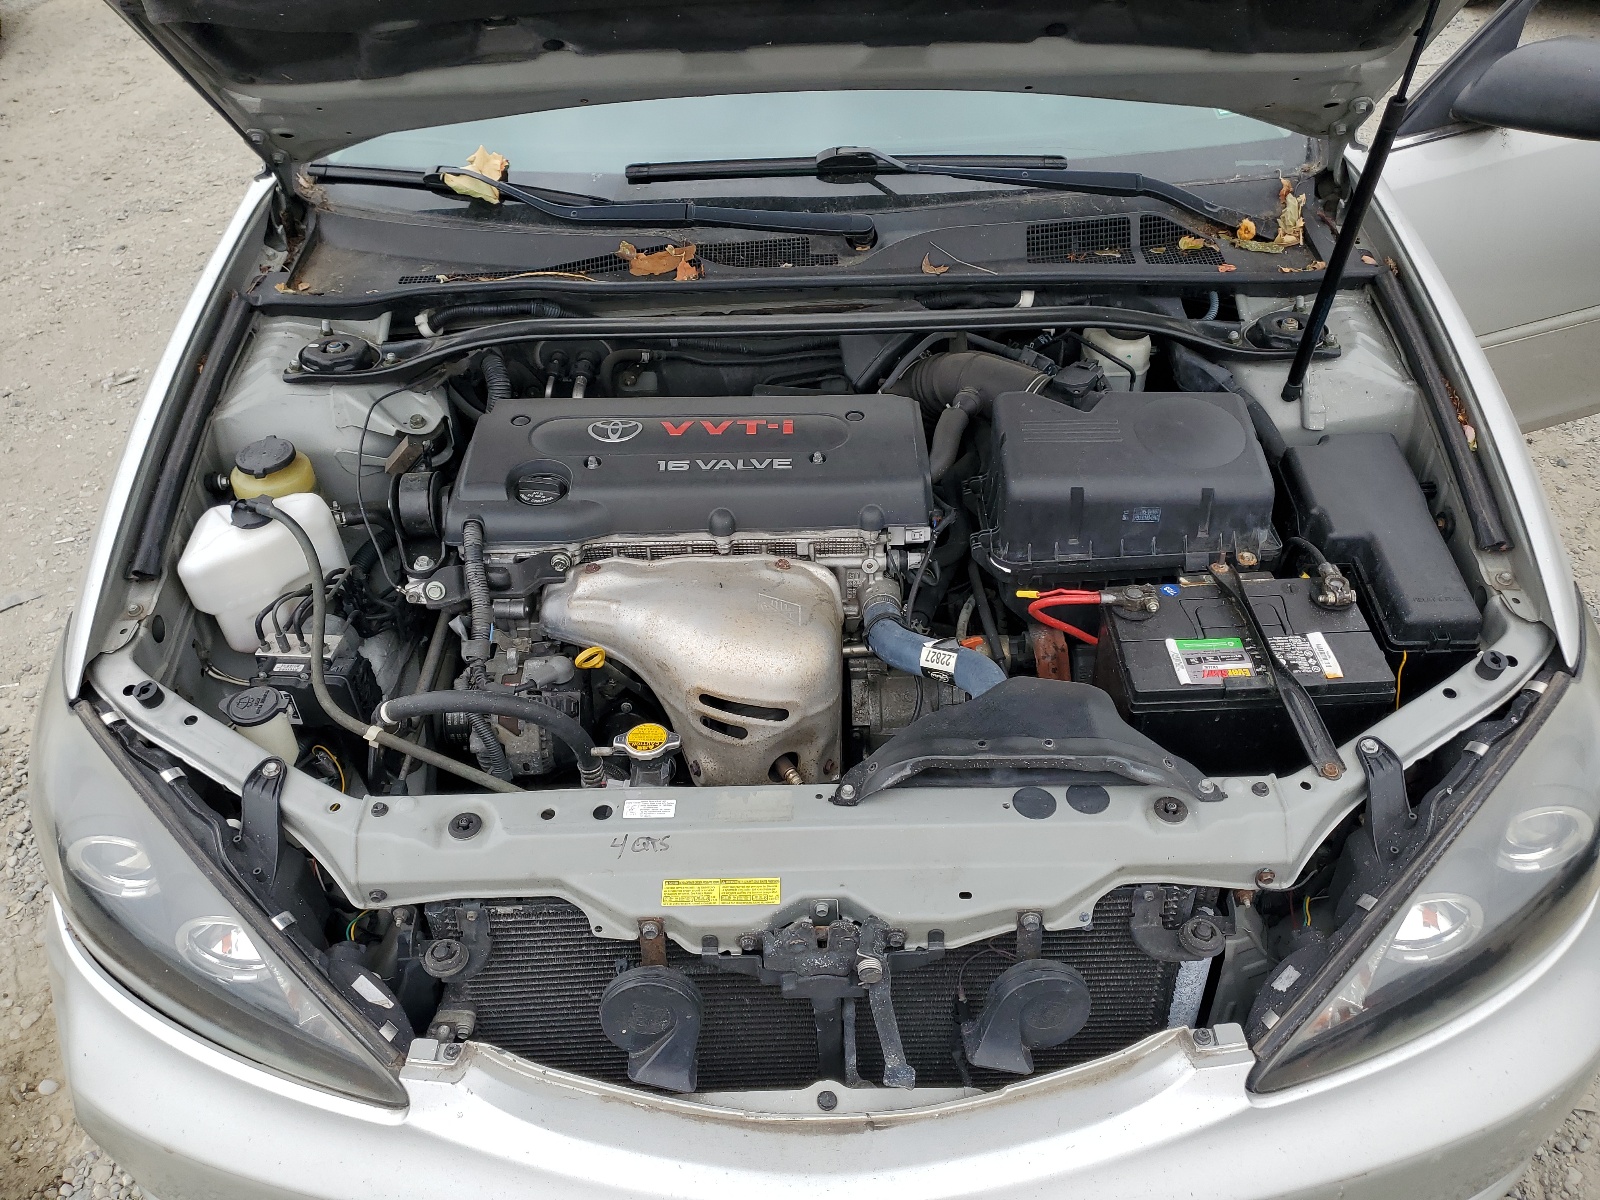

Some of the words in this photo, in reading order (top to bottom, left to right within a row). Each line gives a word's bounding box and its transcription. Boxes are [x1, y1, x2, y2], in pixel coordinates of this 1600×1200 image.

[659, 419, 794, 436] VVT-i
[657, 460, 691, 471] 16
[695, 458, 793, 471] VALVE
[610, 833, 629, 860] 4
